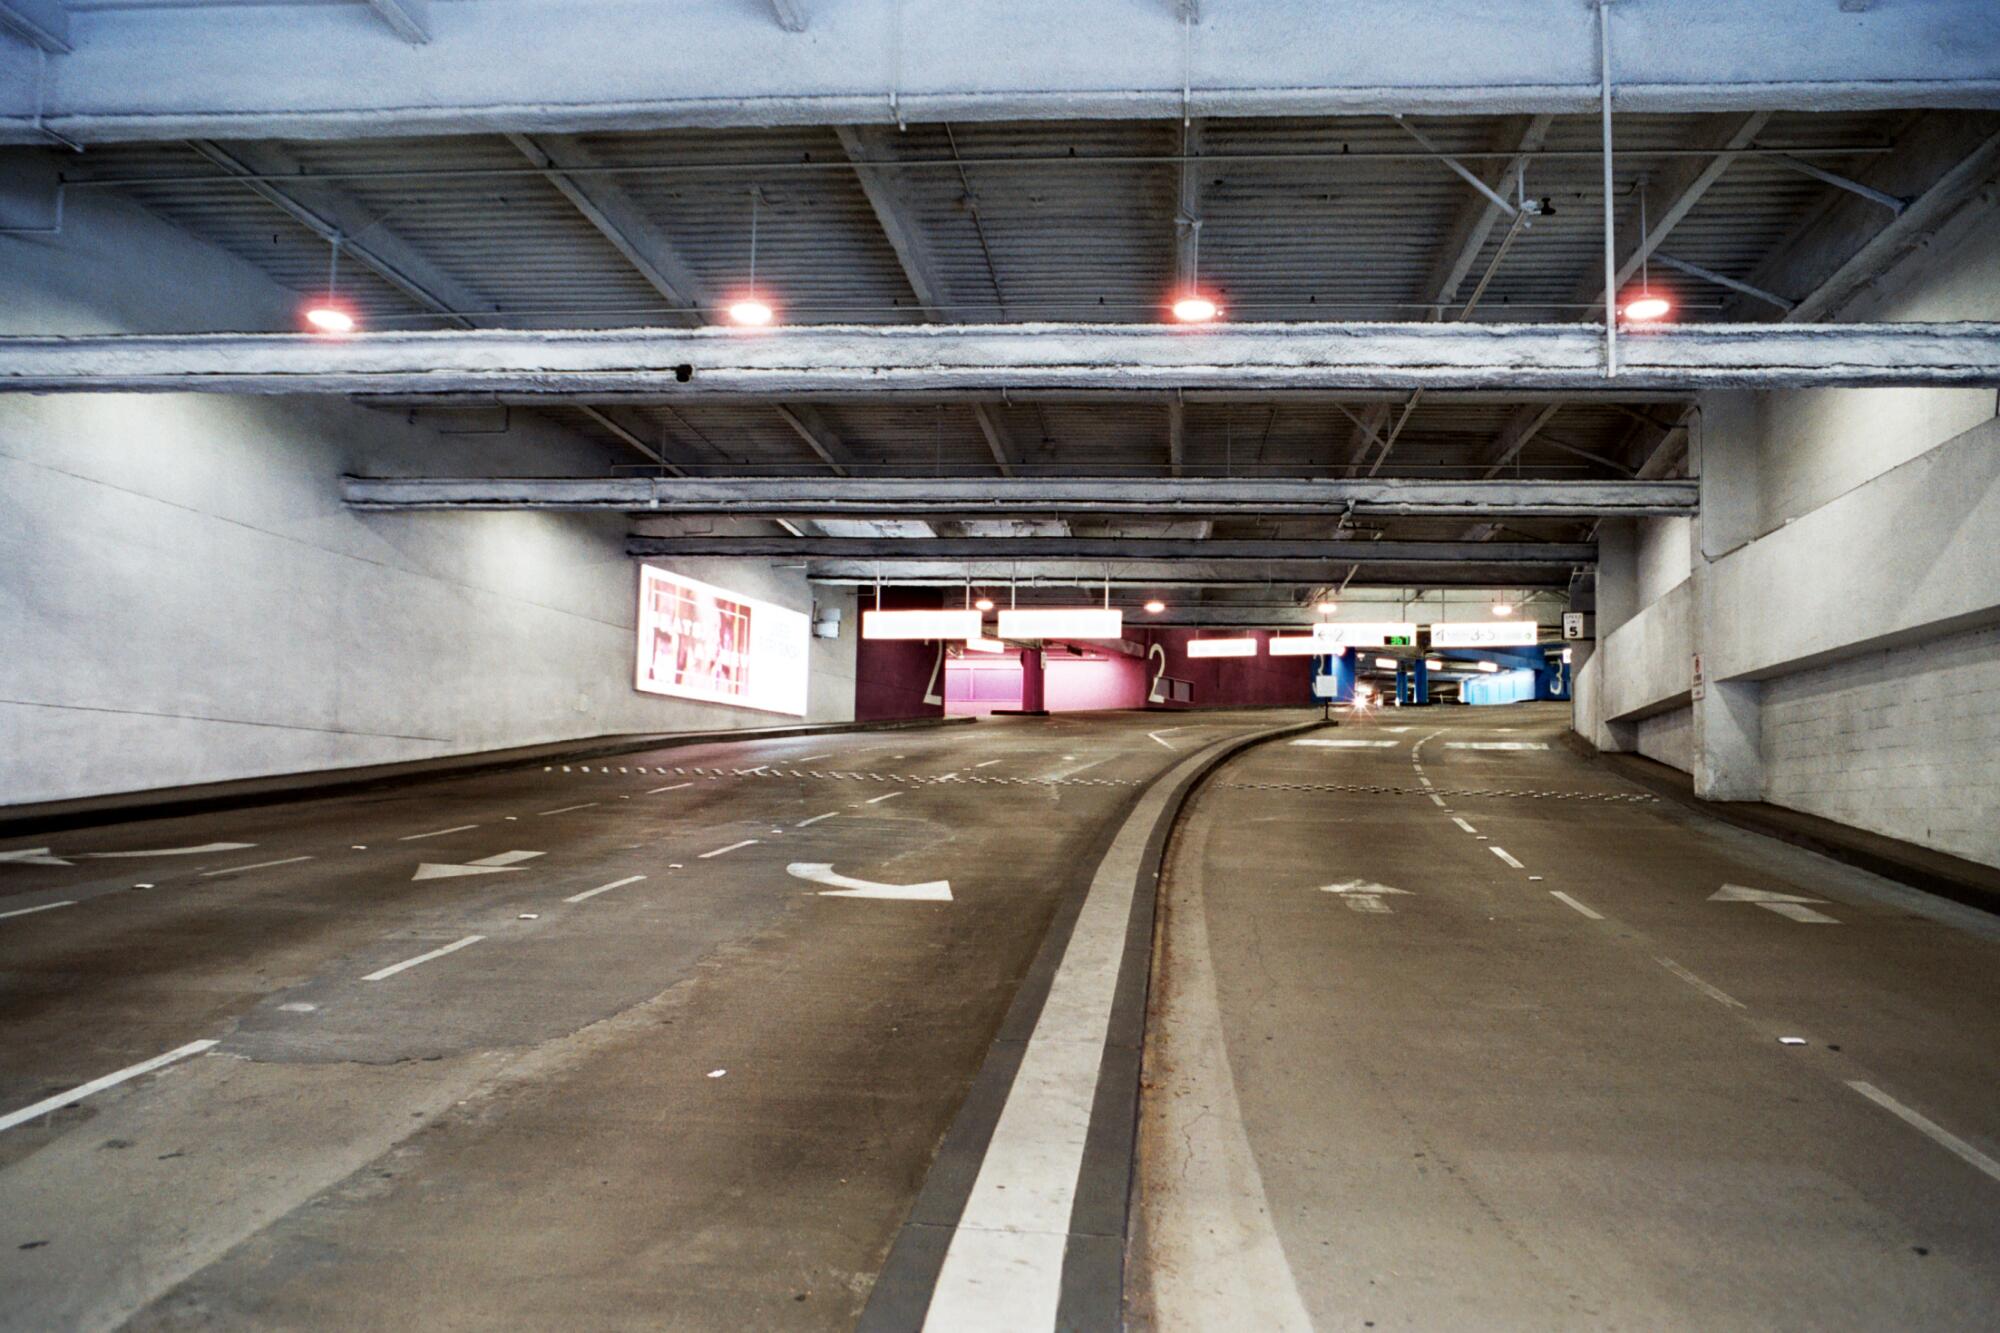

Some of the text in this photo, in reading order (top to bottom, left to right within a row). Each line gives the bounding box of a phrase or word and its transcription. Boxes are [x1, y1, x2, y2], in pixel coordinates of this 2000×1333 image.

[1569, 626, 1578, 637] 5
[1148, 643, 1166, 704] 2
[1549, 658, 1563, 695] 3
